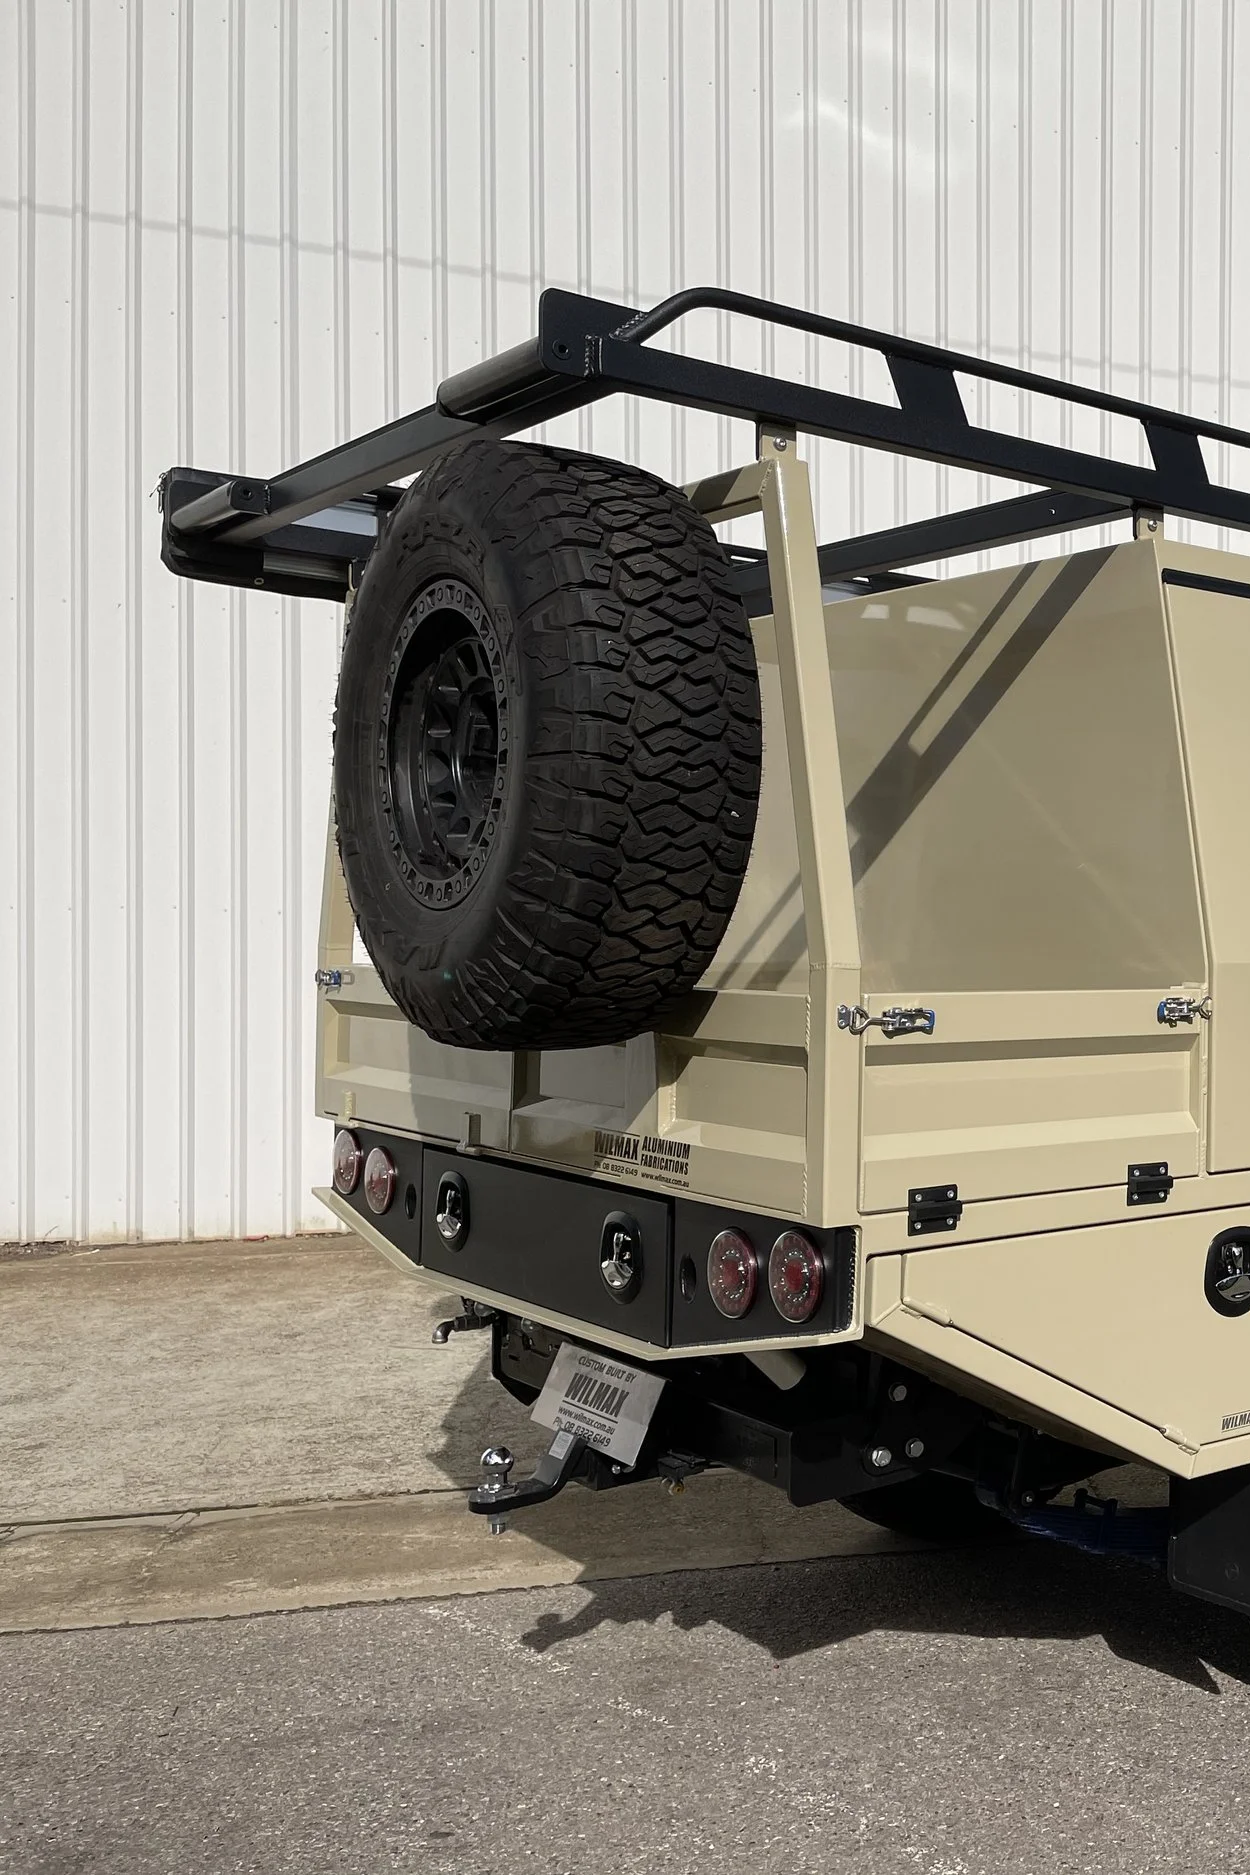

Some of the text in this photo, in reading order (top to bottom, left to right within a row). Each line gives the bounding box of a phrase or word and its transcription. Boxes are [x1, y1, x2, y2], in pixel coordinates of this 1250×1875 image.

[594, 1130, 691, 1161] WILMAX ALUMINIUM
[602, 1161, 610, 1170] 08
[611, 1164, 624, 1173] 8322
[625, 1167, 638, 1176] 6149
[641, 1173, 690, 1187] www.wilmax.com.au
[640, 1153, 689, 1176] FABRICATIONS
[578, 1356, 637, 1384] CUSTOM BUILT BY
[565, 1372, 630, 1418] WILMAX
[558, 1405, 616, 1435] www.wilmax.com.au
[564, 1420, 575, 1433] 08
[574, 1425, 594, 1441] 8322
[592, 1431, 612, 1447] 6149
